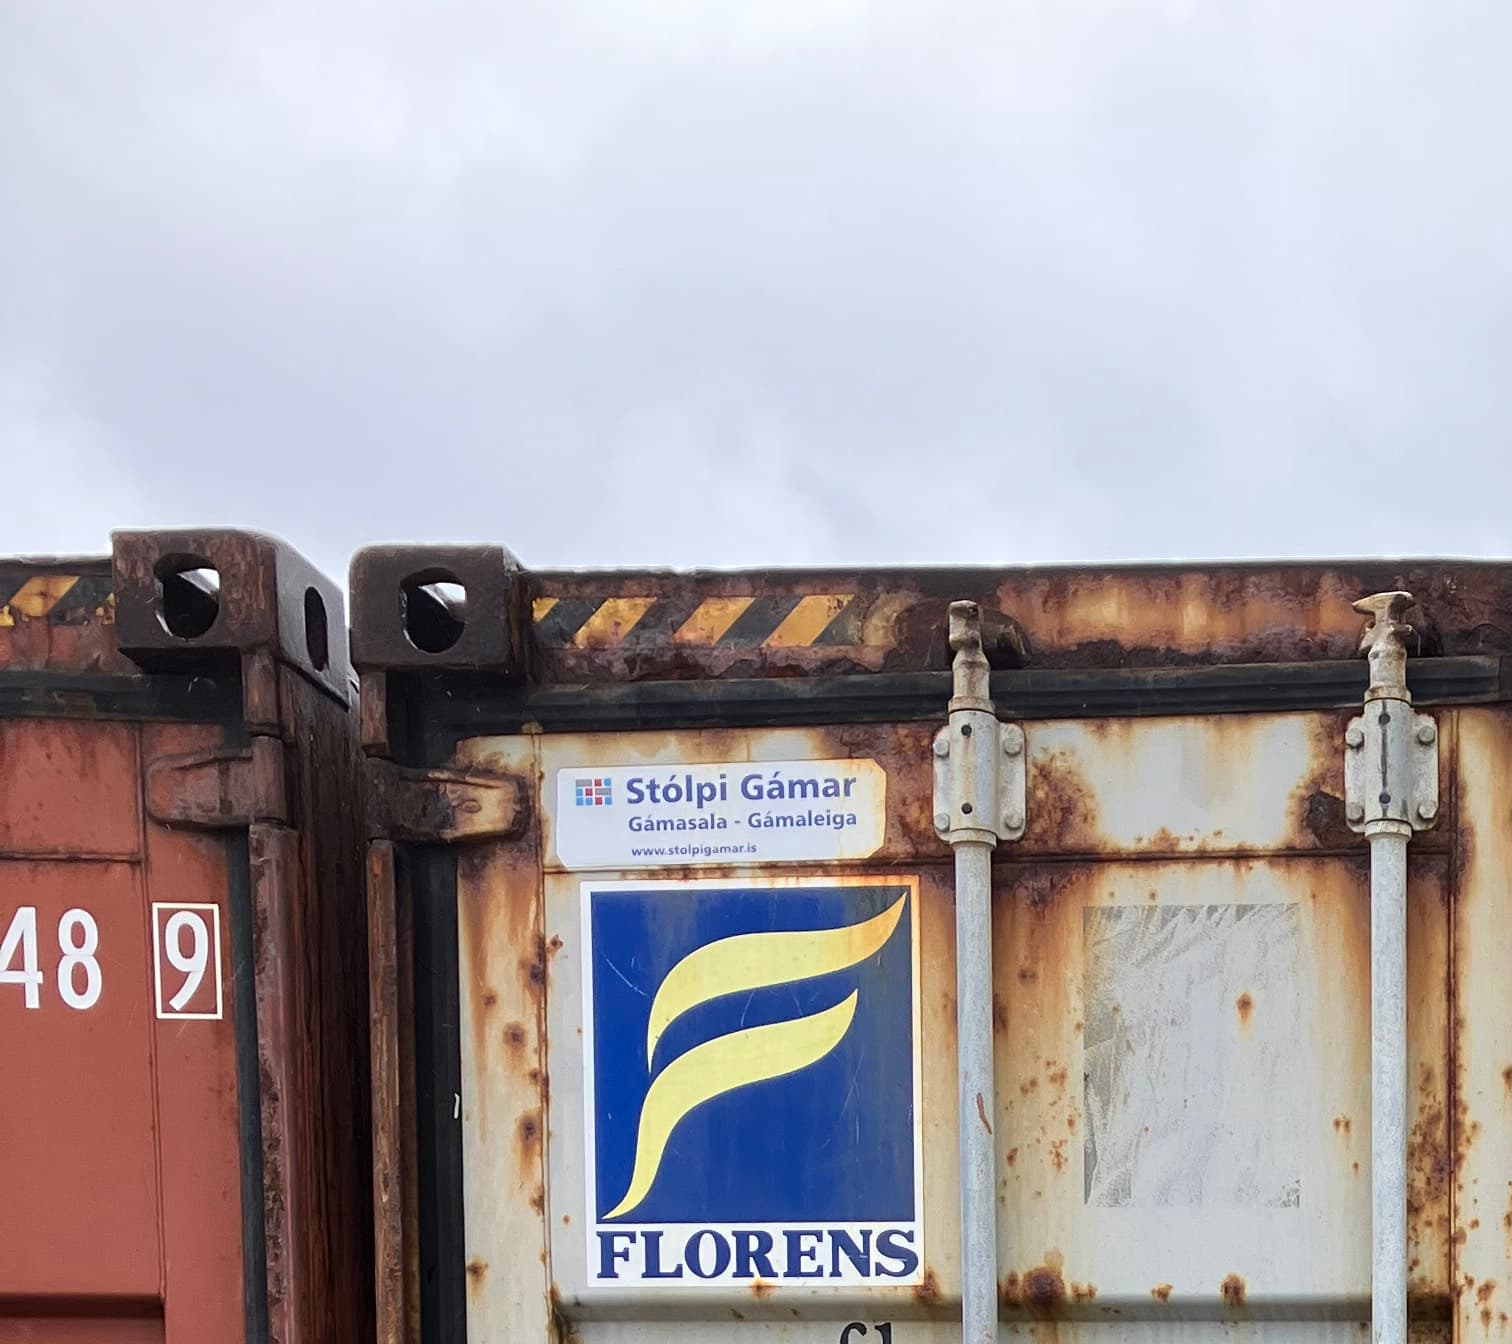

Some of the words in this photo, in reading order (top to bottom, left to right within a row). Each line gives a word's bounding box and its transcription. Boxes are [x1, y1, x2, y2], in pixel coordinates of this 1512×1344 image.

[626, 773, 727, 808] Stólpi
[740, 771, 857, 801] Gámar
[628, 812, 727, 832] Gámasala
[748, 809, 857, 831] Gámaleiga
[631, 843, 757, 857] www.stolpigamar.is
[0, 907, 102, 1010] 48
[165, 910, 209, 1011] 9
[597, 1229, 919, 1279] FLORENS
